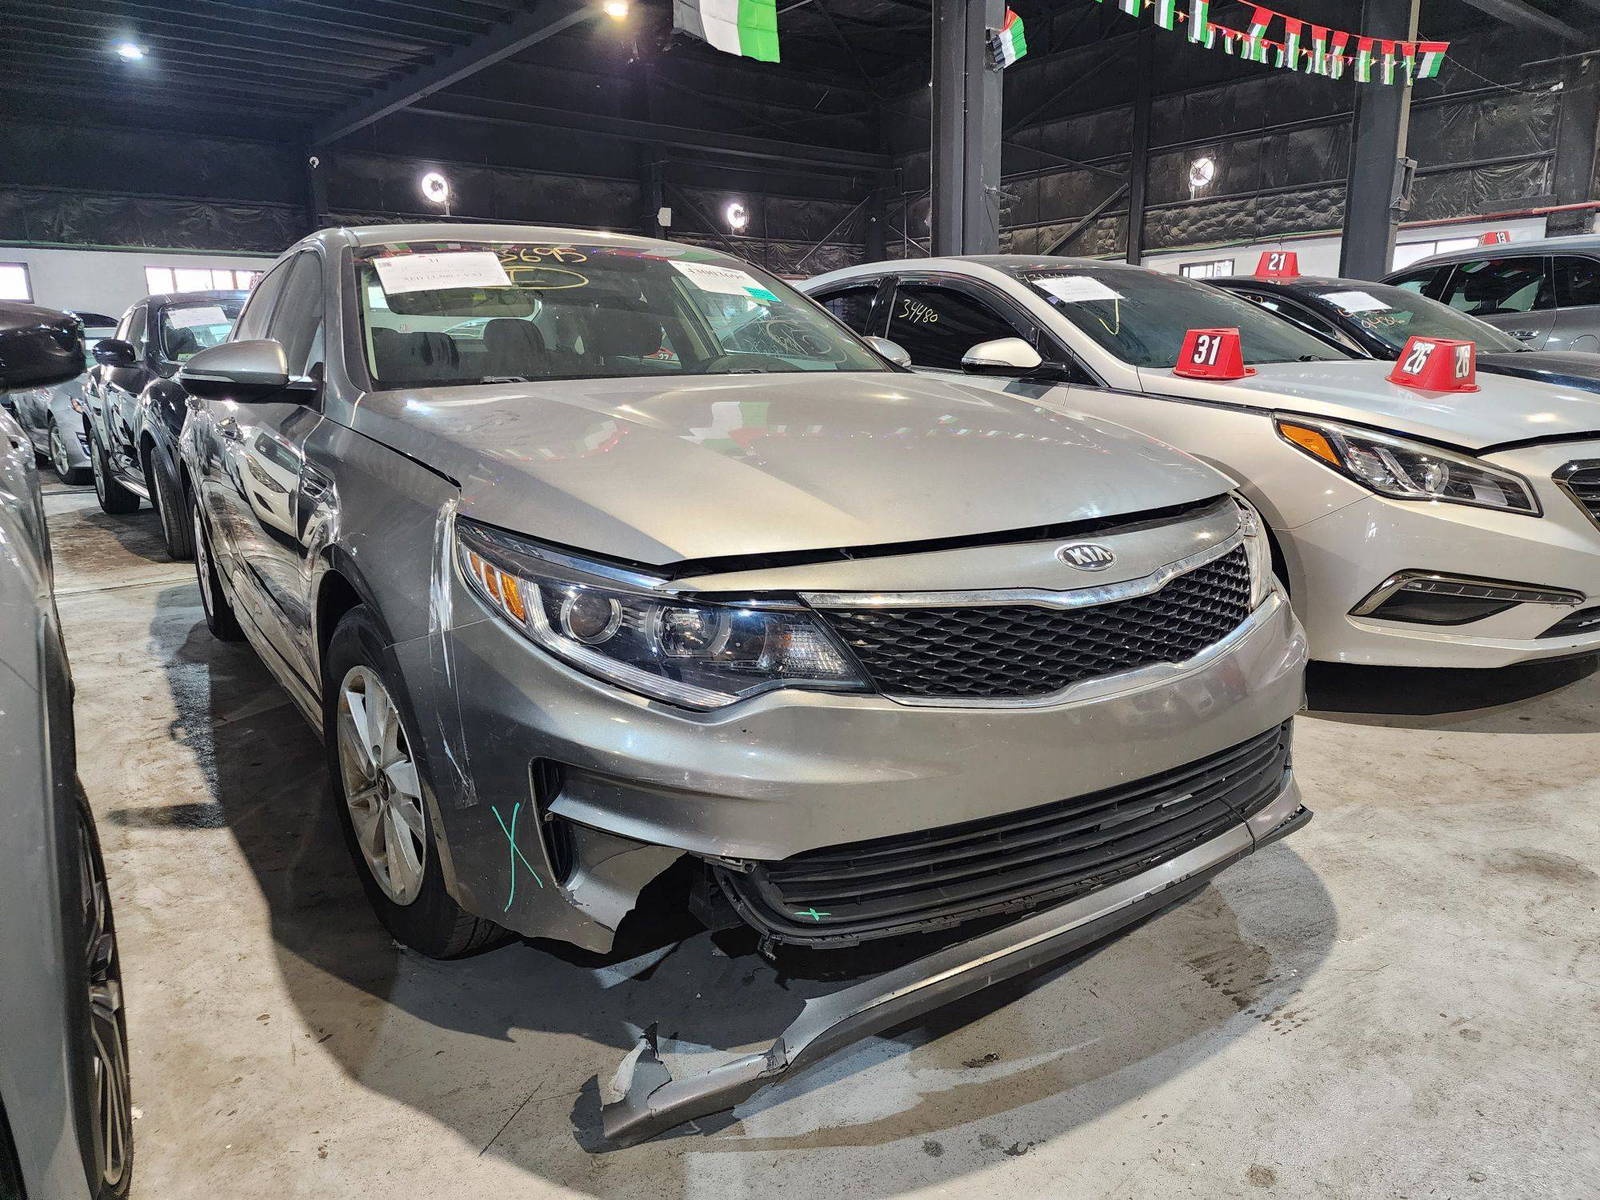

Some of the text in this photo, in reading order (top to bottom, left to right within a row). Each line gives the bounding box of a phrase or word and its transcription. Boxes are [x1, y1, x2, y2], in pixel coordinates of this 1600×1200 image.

[1268, 253, 1287, 271] 21
[898, 298, 938, 323] 34480
[1193, 335, 1220, 365] 31
[1402, 341, 1435, 375] 26
[1455, 345, 1470, 378] 26
[1063, 545, 1112, 565] KIA
